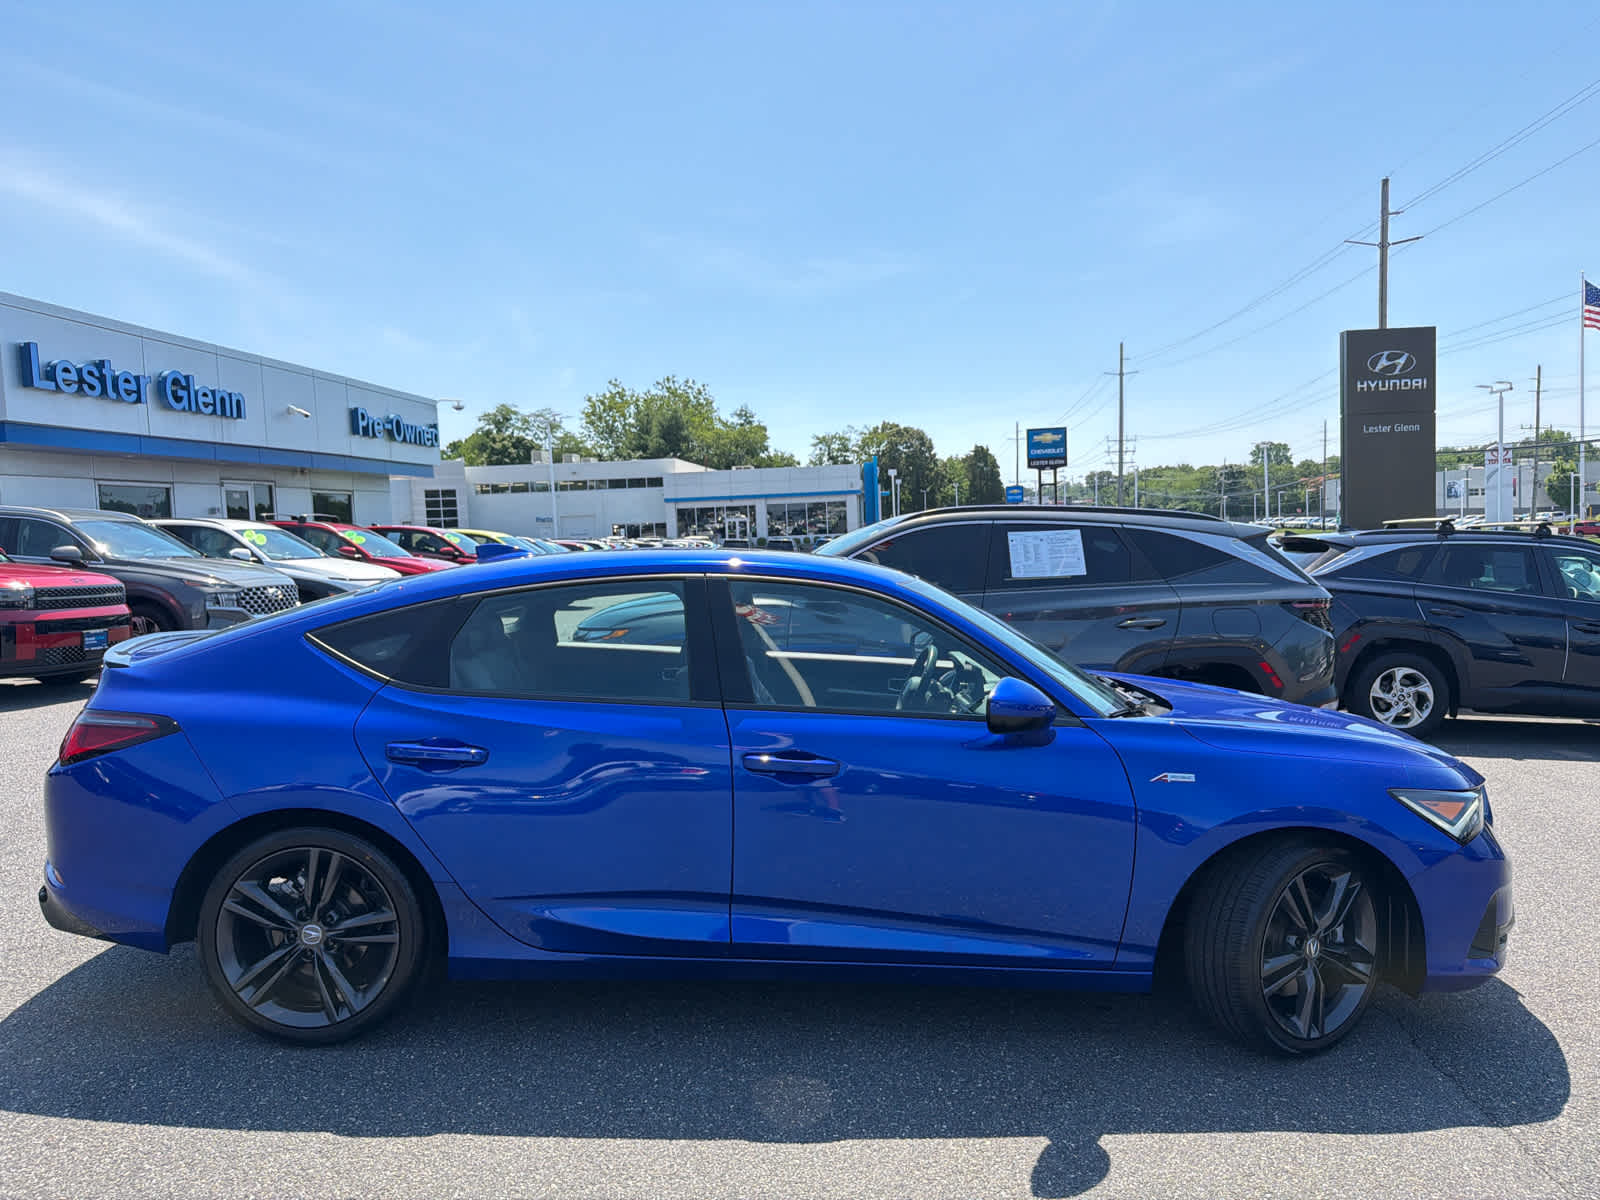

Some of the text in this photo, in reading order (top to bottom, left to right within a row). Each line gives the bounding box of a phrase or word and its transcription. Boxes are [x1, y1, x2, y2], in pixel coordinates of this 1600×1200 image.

[20, 341, 247, 420] Lester Glenn
[1357, 378, 1428, 392] HYUNDAI
[352, 407, 440, 448] Pre-Owned
[1363, 424, 1421, 433] Lester Glenn
[1030, 447, 1065, 455] CHEVROLET
